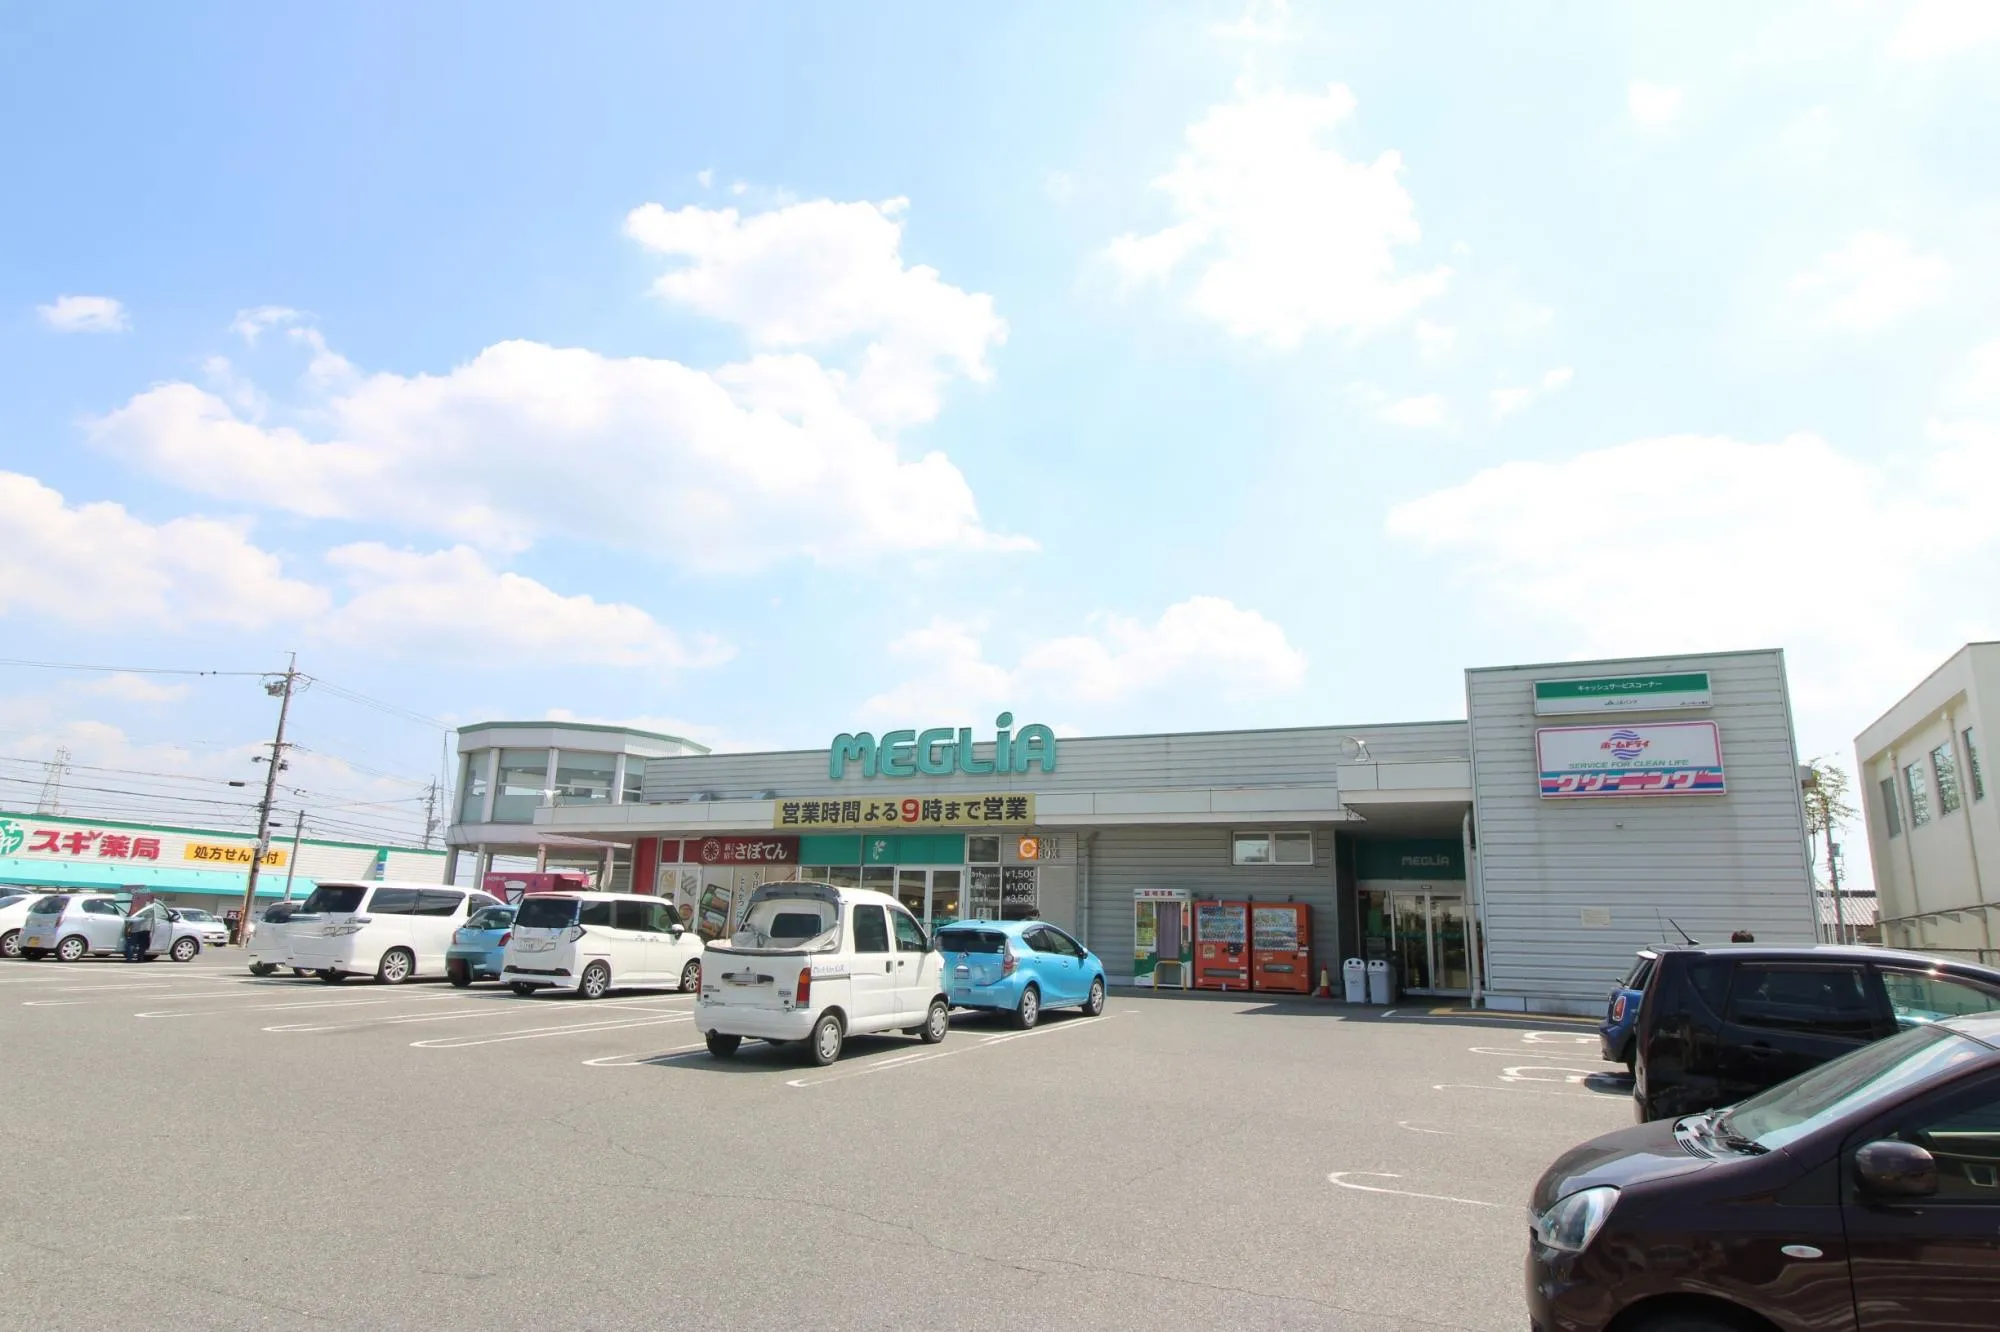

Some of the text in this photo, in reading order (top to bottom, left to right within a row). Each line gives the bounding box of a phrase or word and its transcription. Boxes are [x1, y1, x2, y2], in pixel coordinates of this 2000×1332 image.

[1577, 682, 1663, 692] キャッシュサービスコーナー
[1600, 739, 1650, 750] ホームドライ
[1568, 761, 1608, 769] SERVICE
[1556, 770, 1711, 792] クリーニング
[28, 829, 160, 861] スギ薬局
[735, 842, 788, 860] さぼてん
[194, 845, 280, 865] 処方せん付
